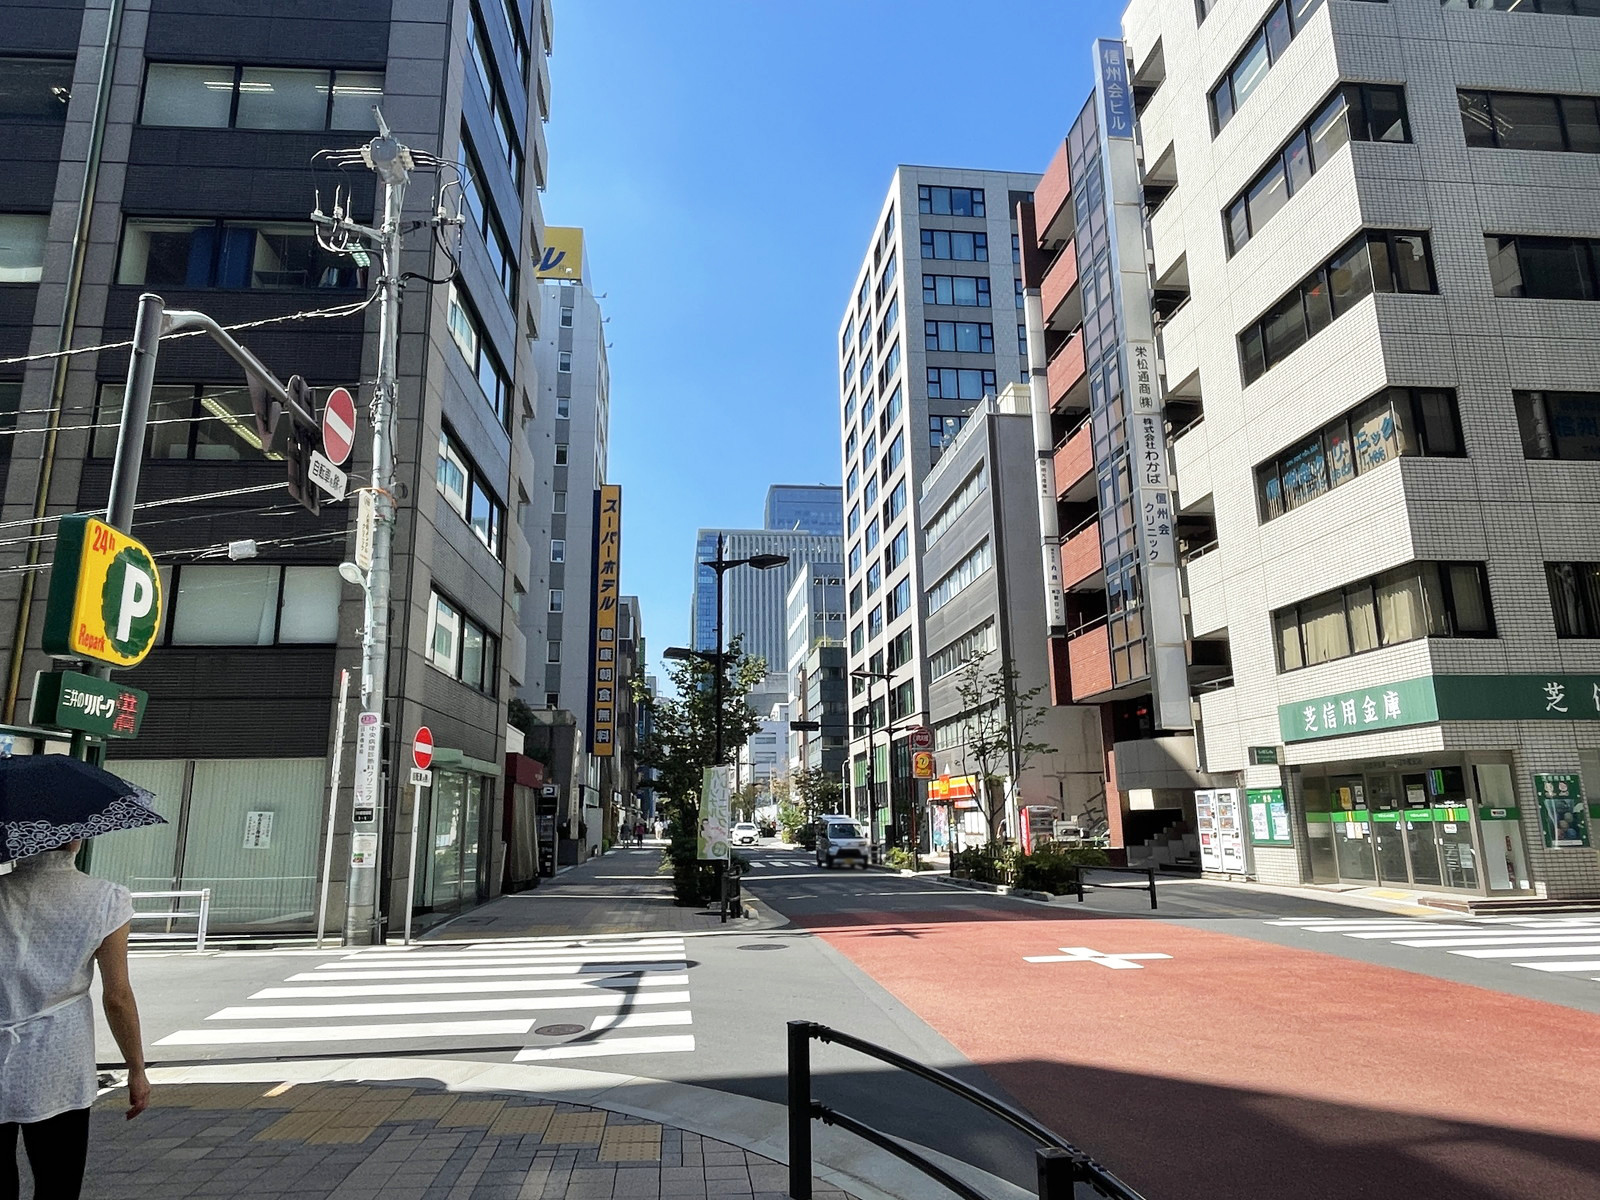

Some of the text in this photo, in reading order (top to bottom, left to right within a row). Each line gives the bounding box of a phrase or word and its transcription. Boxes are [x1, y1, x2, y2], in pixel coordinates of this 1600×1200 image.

[1104, 49, 1126, 130] 信州会ビル
[1143, 417, 1161, 485] 株式会社わかば
[93, 524, 115, 556] 24h
[1145, 502, 1159, 562] クリニック
[1155, 492, 1170, 536] 信州会
[599, 499, 618, 611] スーパーホテル
[116, 562, 153, 643] P
[78, 624, 105, 653] Repark
[62, 688, 116, 719] 三井のリパーク
[596, 628, 614, 744] 健康朝食無料
[1303, 690, 1402, 732] 芝信用金庫
[543, 786, 554, 795] P
